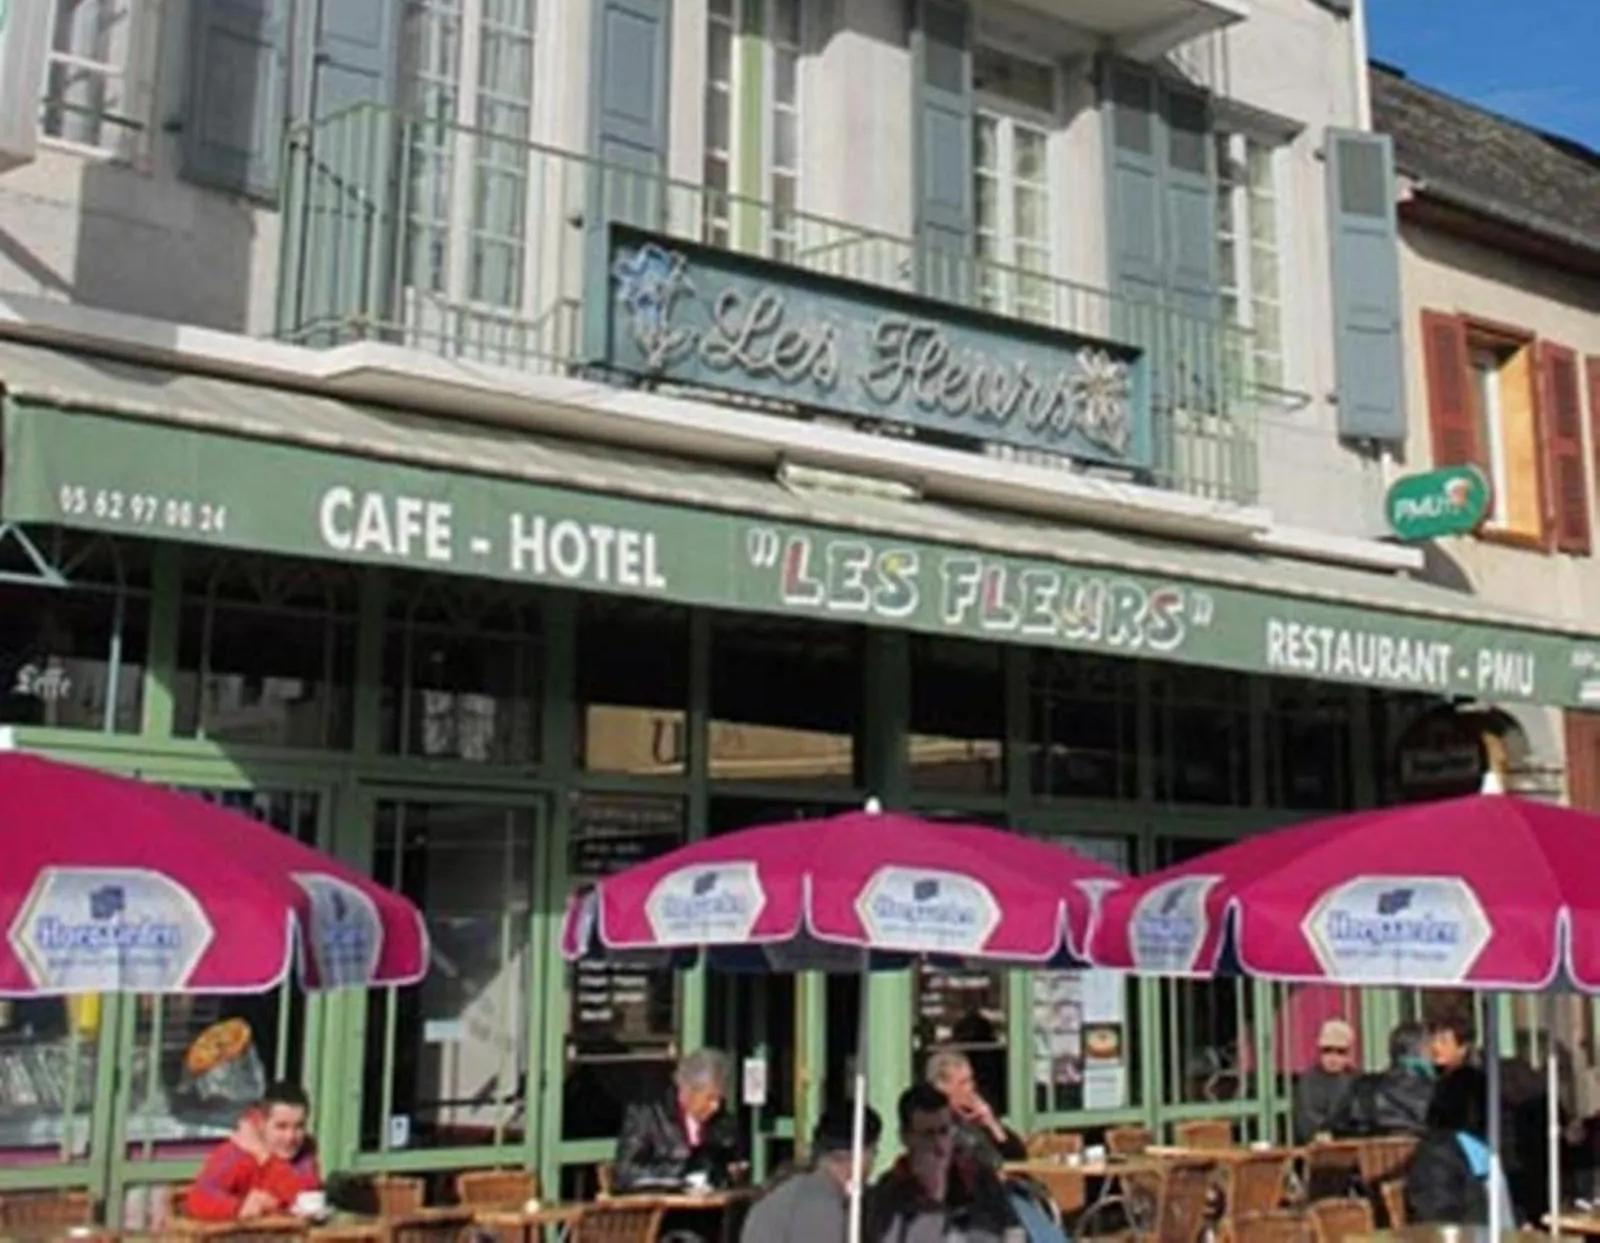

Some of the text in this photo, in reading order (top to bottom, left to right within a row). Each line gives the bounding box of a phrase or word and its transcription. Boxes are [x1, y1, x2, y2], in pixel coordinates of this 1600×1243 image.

[700, 286, 1079, 438] Les Fleurs
[59, 483, 87, 515] 05
[94, 489, 123, 520] 62
[130, 493, 158, 523] 97
[319, 486, 667, 589] CAFE - HOTEL
[1394, 496, 1444, 524] PMU
[1266, 620, 1452, 685] RESTAURANT
[1476, 649, 1535, 694] PMU
